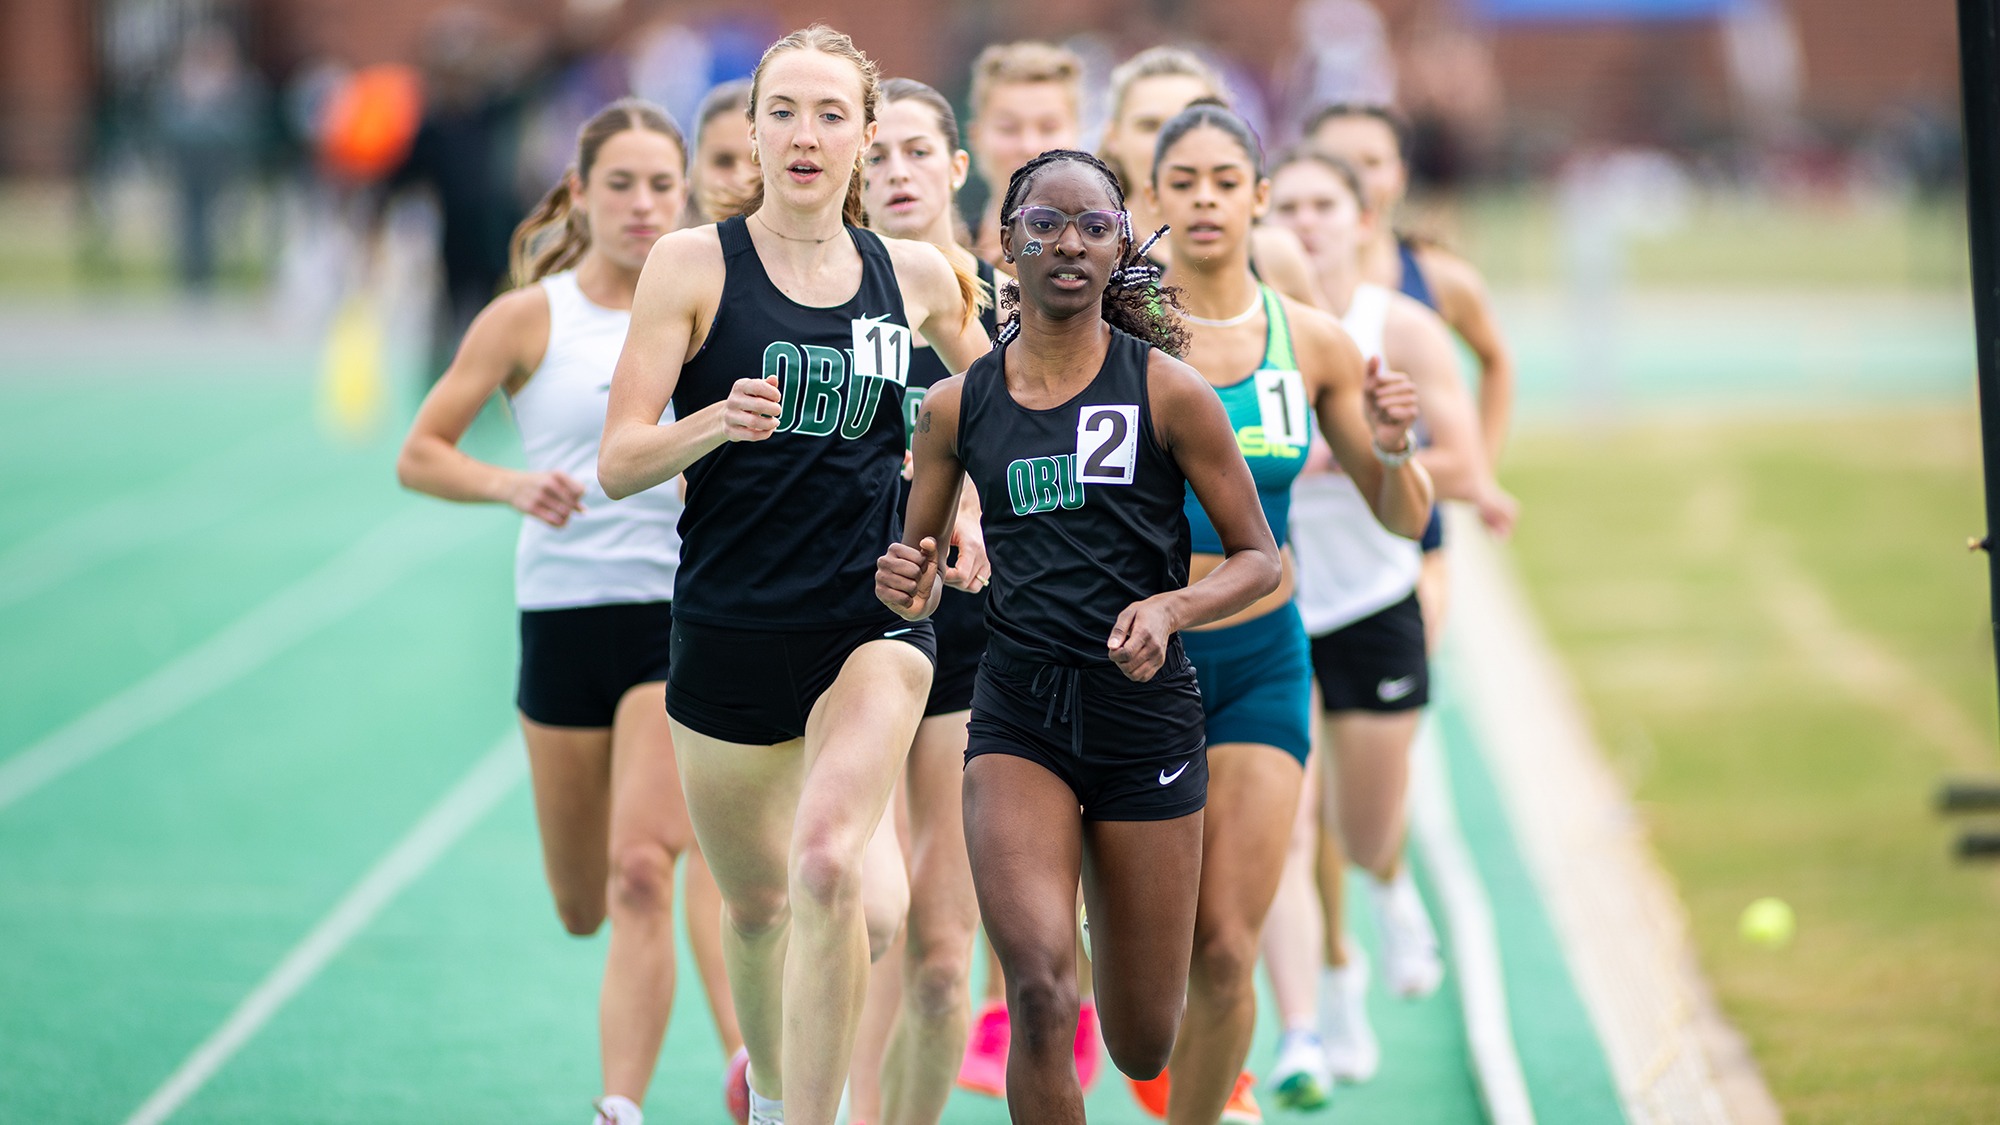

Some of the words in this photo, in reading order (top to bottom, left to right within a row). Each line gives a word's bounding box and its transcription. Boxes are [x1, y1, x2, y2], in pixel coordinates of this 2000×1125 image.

[866, 326, 901, 380] 11
[762, 341, 885, 439] OBU
[1269, 378, 1291, 436] 1
[1083, 410, 1127, 478] 2
[1007, 454, 1085, 516] OBU
